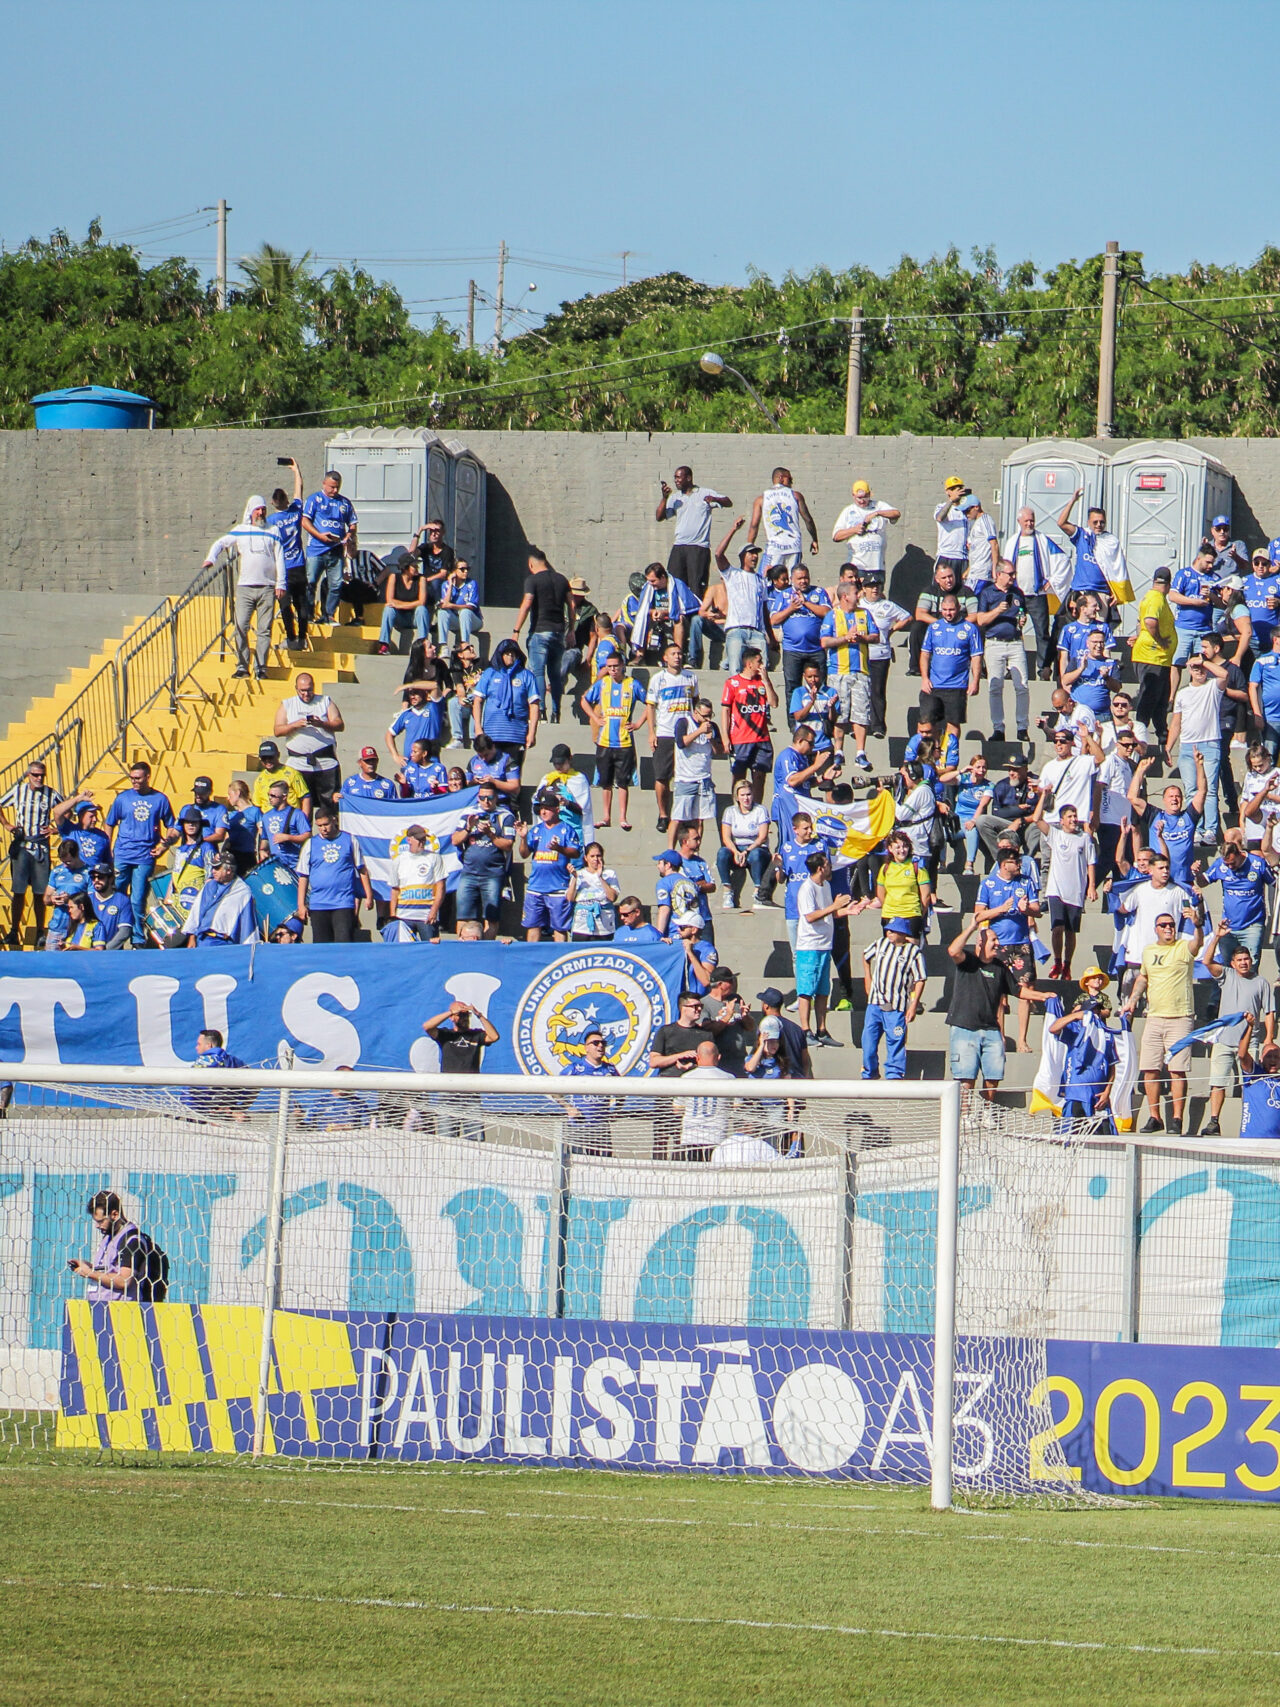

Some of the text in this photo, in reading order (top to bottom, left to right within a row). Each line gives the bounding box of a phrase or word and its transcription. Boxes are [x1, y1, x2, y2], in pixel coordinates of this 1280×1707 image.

[935, 646, 961, 656] OSCAR
[524, 956, 635, 1013] UNIFORMIZADA
[636, 970, 656, 992] DO
[651, 994, 665, 1026] SÃO
[1241, 1102, 1249, 1133] INOVAR
